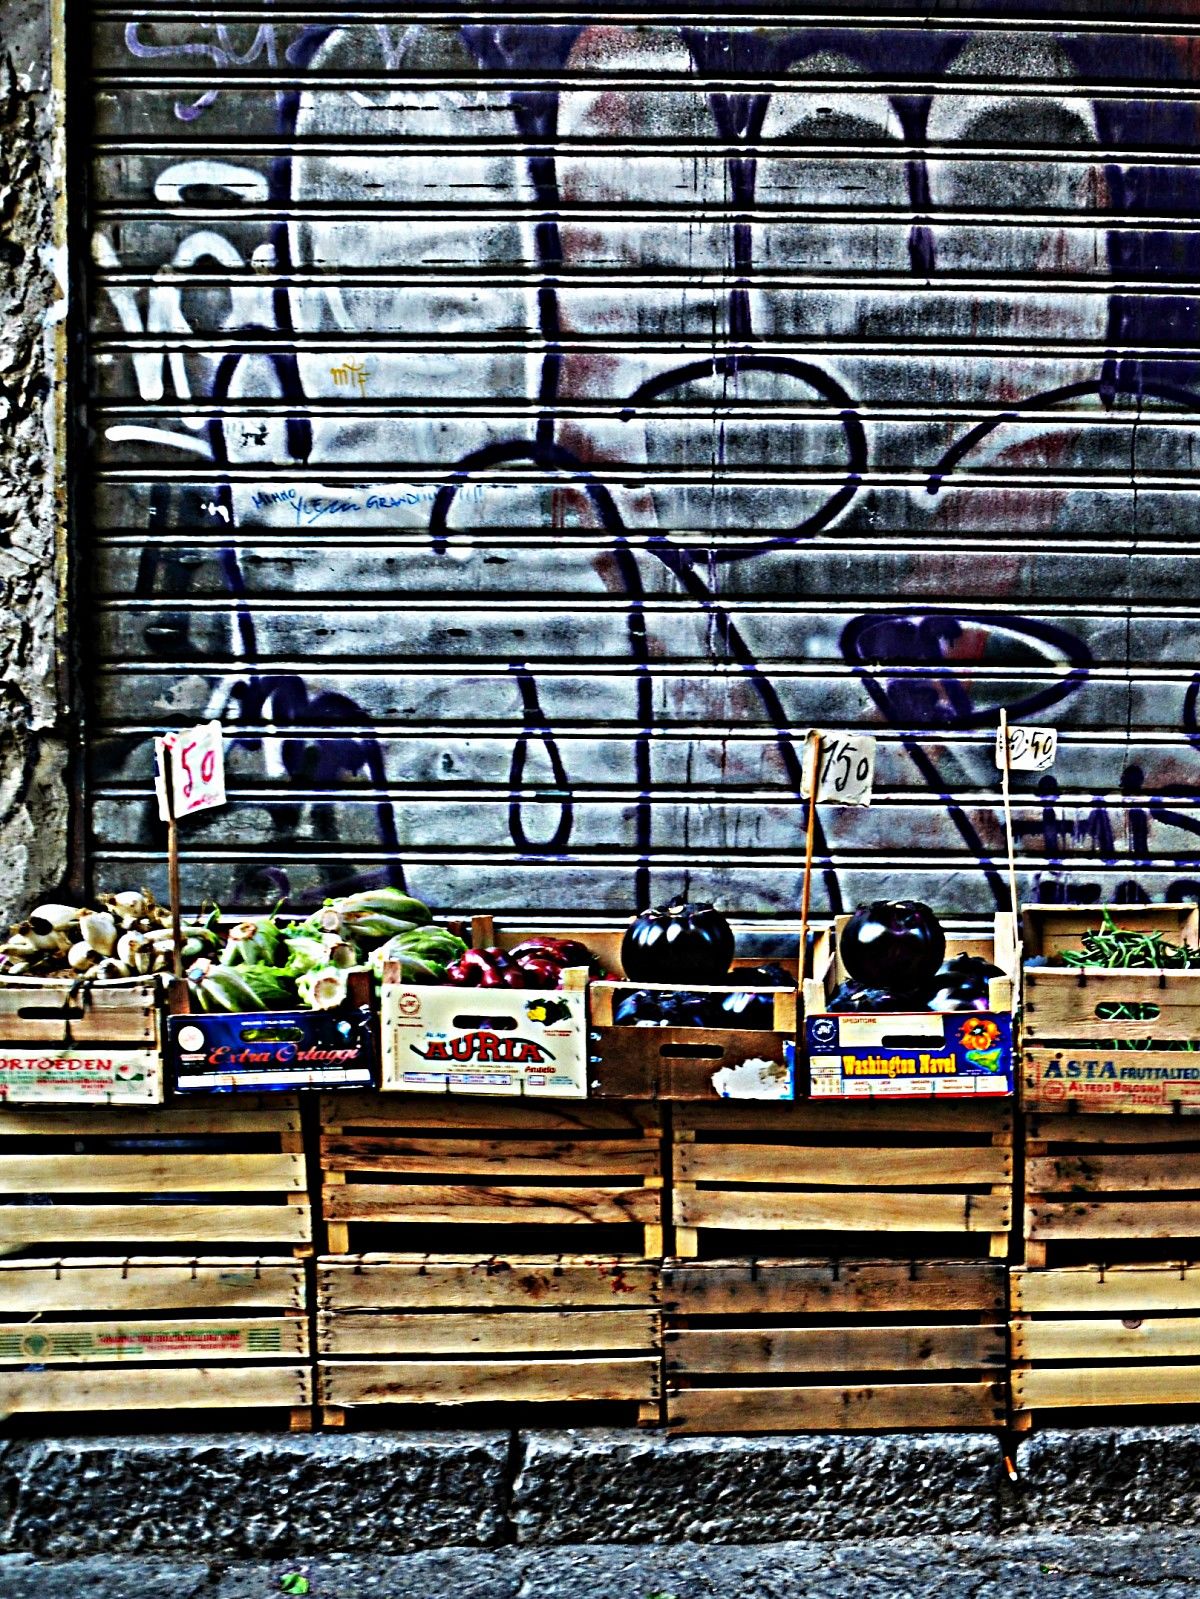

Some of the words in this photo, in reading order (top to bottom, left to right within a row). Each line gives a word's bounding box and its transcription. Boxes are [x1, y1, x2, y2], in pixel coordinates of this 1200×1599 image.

[207, 1047, 270, 1065] Extra
[275, 1044, 359, 1065] Ortaggi
[425, 1032, 544, 1062] AURIA
[842, 1055, 916, 1078] Washington
[919, 1053, 956, 1074] Navel
[1043, 1060, 1118, 1079] ASTA
